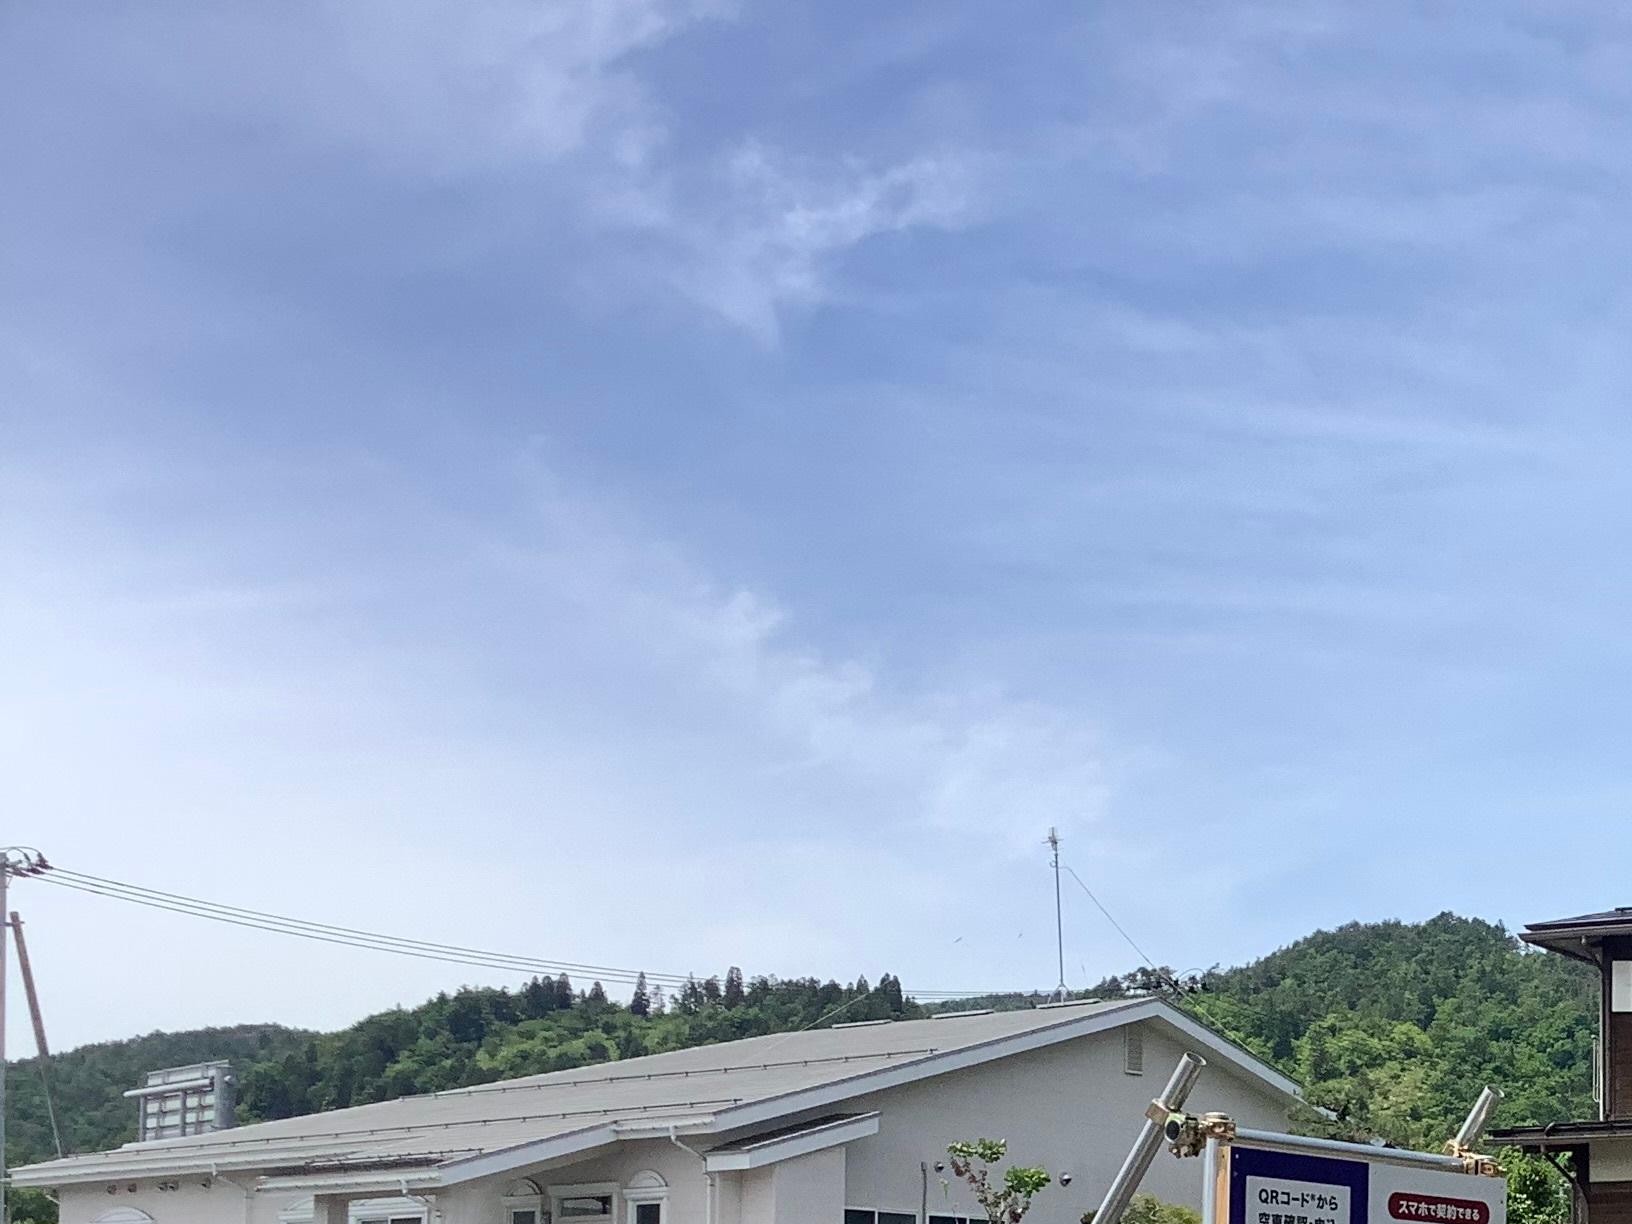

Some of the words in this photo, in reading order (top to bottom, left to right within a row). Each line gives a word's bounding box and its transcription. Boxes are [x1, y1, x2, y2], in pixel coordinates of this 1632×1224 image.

[1398, 1200, 1480, 1221] スマホで契約できる
